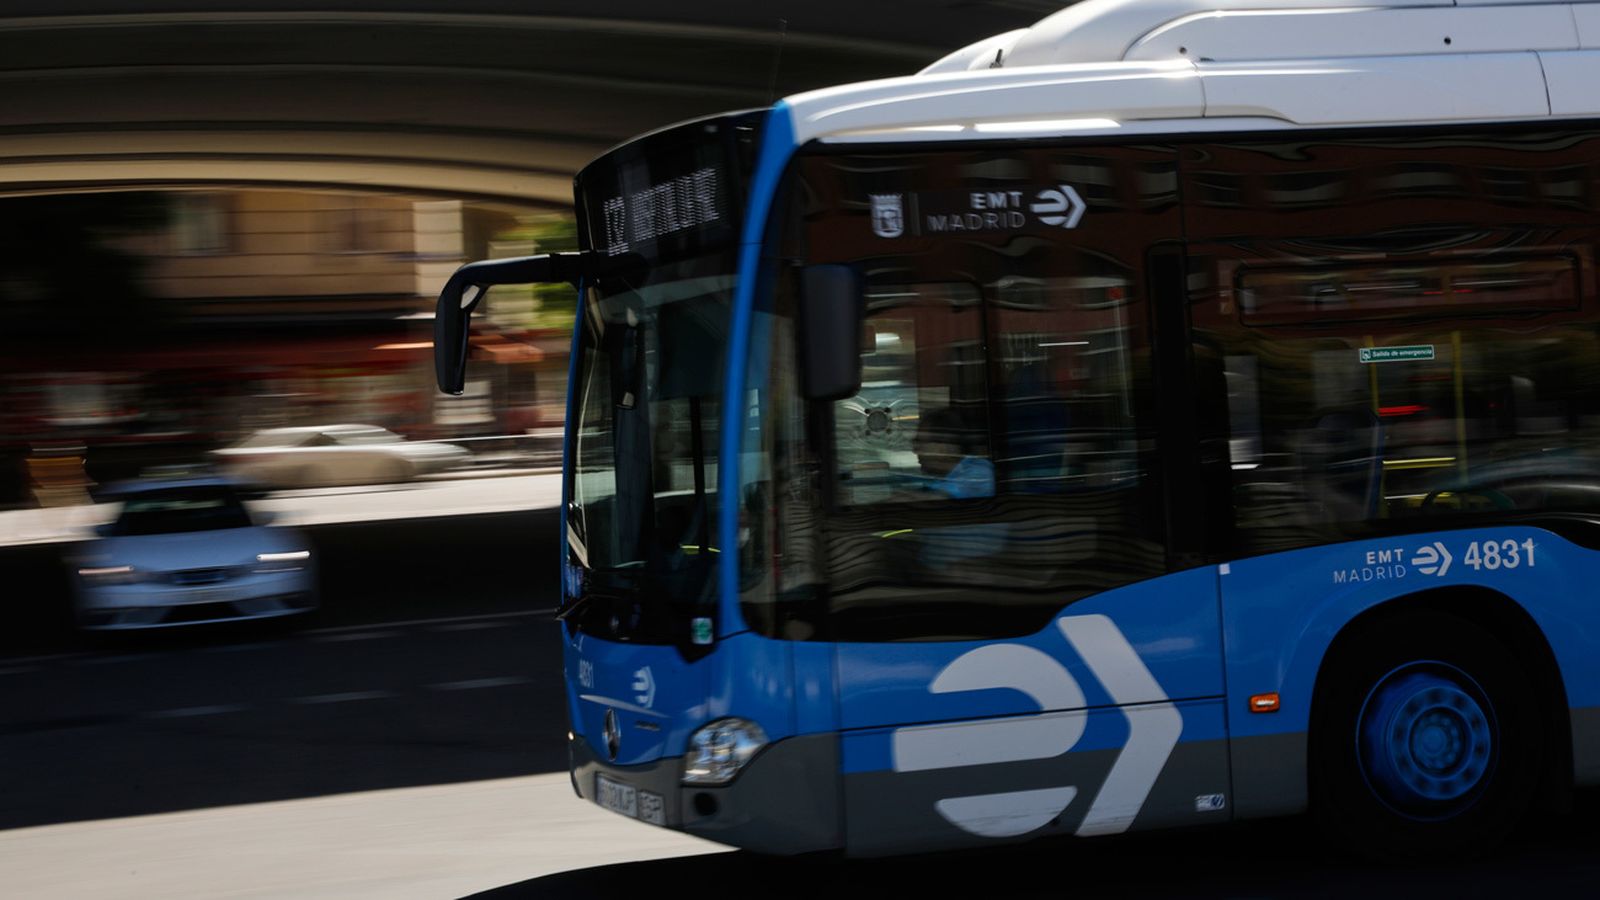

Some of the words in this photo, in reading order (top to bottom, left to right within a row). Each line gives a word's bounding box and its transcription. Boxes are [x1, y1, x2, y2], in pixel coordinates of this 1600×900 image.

[970, 191, 1023, 209] EMT
[928, 212, 1025, 231] MADRID
[1366, 549, 1404, 565] EMT
[1464, 538, 1536, 571] 4831
[1333, 564, 1407, 584] MADRID
[578, 659, 594, 688] 4831
